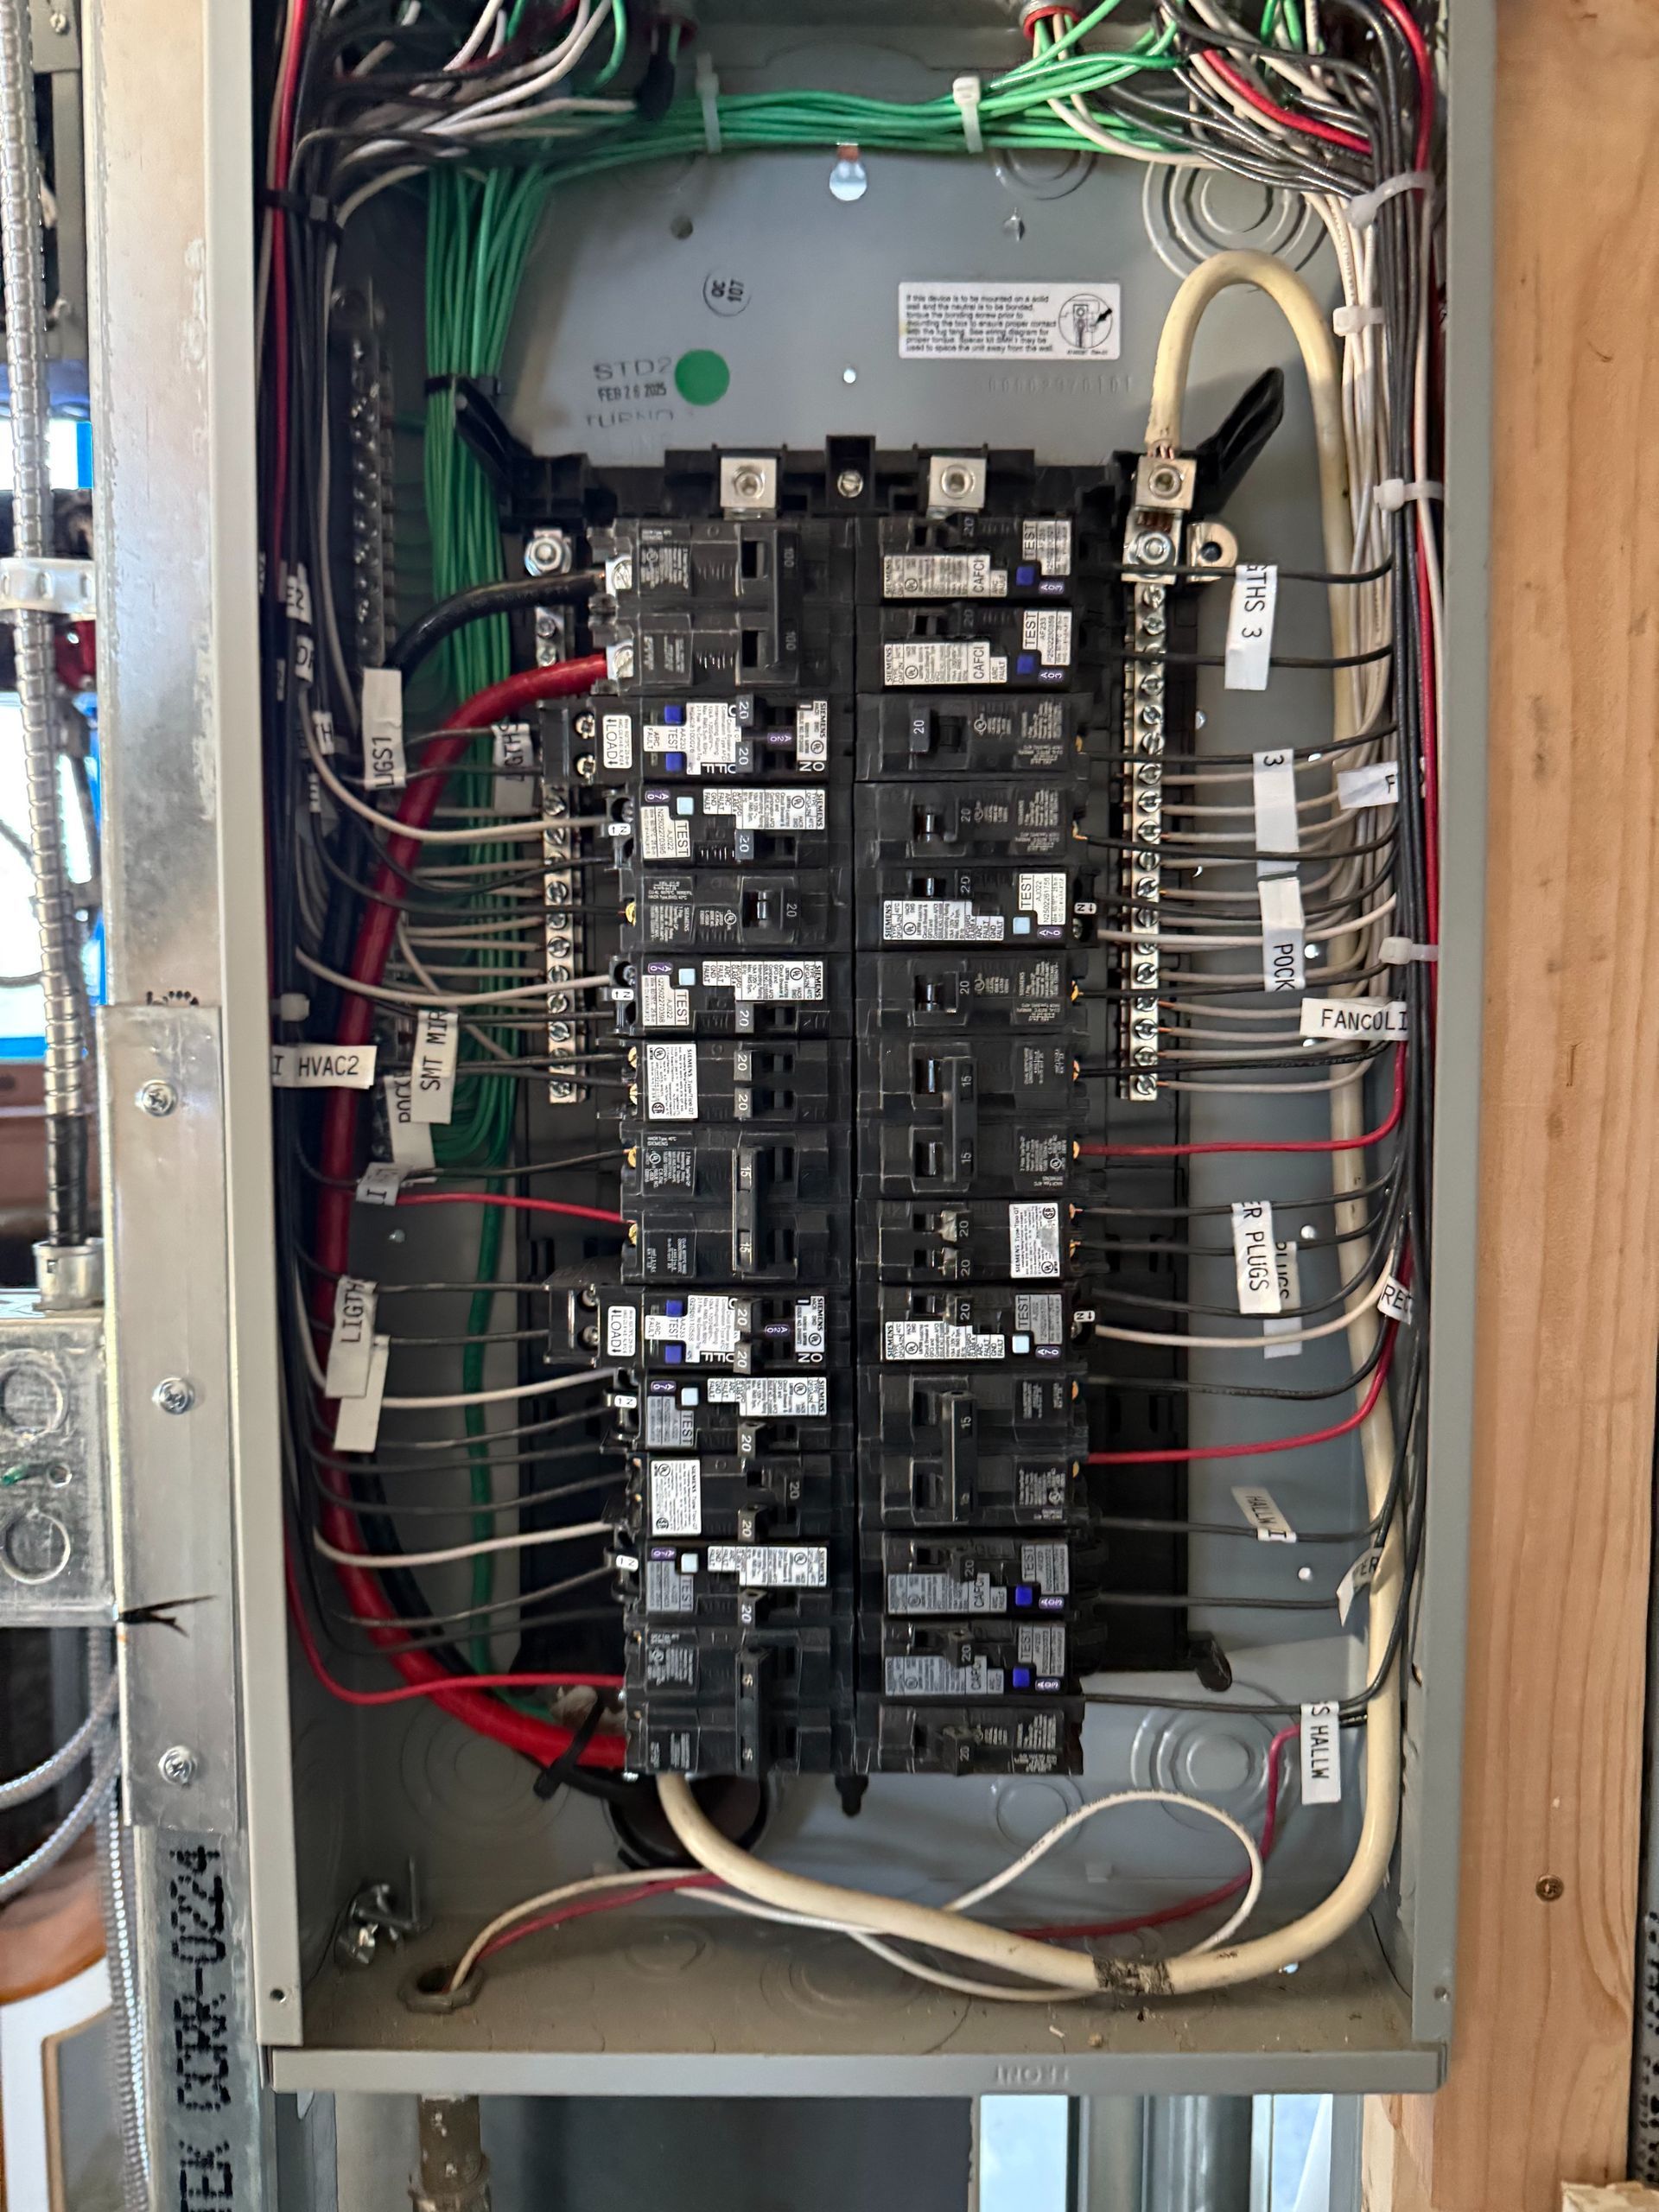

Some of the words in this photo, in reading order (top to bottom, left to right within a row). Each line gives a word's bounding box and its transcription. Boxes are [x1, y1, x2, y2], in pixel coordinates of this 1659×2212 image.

[711, 280, 725, 298] QC
[728, 279, 744, 302] 107
[594, 356, 672, 380] STD2
[598, 385, 621, 402] FEB
[645, 382, 667, 398] 2025
[1024, 524, 1036, 558] TEST
[973, 560, 985, 593] CAFCI
[1025, 612, 1036, 647] TEST
[1242, 626, 1263, 639] 3
[973, 646, 985, 680] CAFCI
[739, 702, 749, 720] 20
[913, 720, 925, 734] 20
[606, 724, 617, 760] LOAD
[668, 728, 678, 753] TEST
[739, 748, 749, 766] 20
[961, 808, 971, 823] 20
[677, 823, 689, 856] TEST
[739, 836, 749, 853] 20
[960, 876, 970, 893] 20
[1021, 876, 1033, 909] TEST
[787, 903, 798, 918] 20
[1077, 904, 1085, 912] N
[650, 964, 672, 973] A70
[1273, 944, 1296, 991] POCK
[623, 990, 631, 999] N
[960, 981, 970, 995] 20
[676, 991, 688, 1025] TEST
[739, 1009, 749, 1027] 20
[298, 1055, 359, 1077] HVAC2
[738, 1055, 747, 1071] 20
[420, 1056, 443, 1091] SMT
[961, 1075, 972, 1087] 15
[739, 1095, 748, 1111] 20
[961, 1152, 972, 1164] 15
[959, 1219, 969, 1237] 20
[961, 1259, 971, 1277] 20
[1245, 1231, 1269, 1292] PLUGS
[340, 1280, 365, 1344] LIGTH
[737, 1308, 747, 1326] 20
[960, 1302, 970, 1320] 20
[1018, 1296, 1029, 1329] TEST
[611, 1313, 621, 1348] LOAD
[669, 1319, 678, 1338] TEST
[737, 1351, 747, 1368] 20
[682, 1414, 693, 1446] TEST
[741, 1434, 752, 1452] 20
[790, 1481, 800, 1499] 20
[742, 1520, 752, 1537] 20
[965, 1559, 976, 1577] 20
[1024, 1548, 1035, 1578] TEST
[682, 1579, 691, 1610] TEST
[741, 1605, 752, 1624] 20
[962, 1644, 971, 1661] 20
[1021, 1630, 1032, 1660] TEST
[960, 1745, 970, 1761] 20
[1310, 1725, 1330, 1779] HALLW
